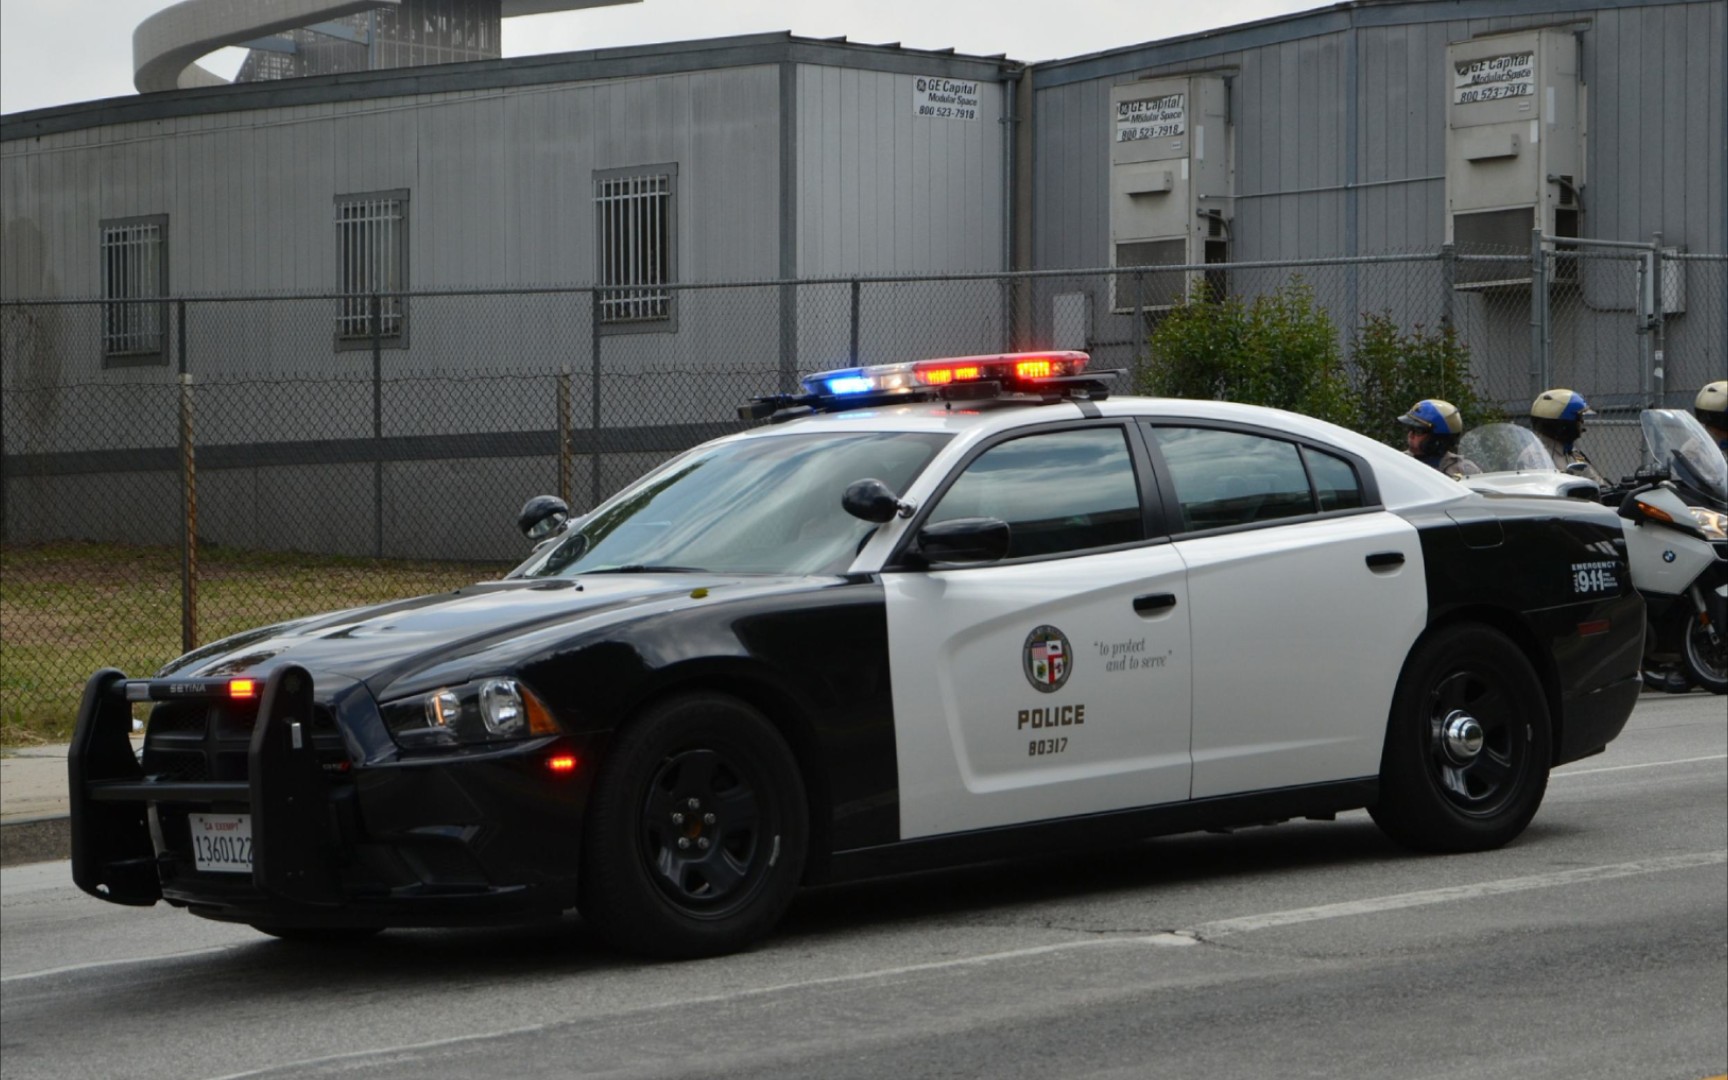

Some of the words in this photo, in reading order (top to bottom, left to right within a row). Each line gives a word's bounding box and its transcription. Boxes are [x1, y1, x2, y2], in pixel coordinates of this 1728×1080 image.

[1471, 61, 1486, 72] GE
[1488, 55, 1530, 71] Capital
[1471, 71, 1505, 83] Modular
[1506, 68, 1531, 80] Space
[928, 79, 941, 91] GE
[943, 80, 978, 95] Capital
[1461, 90, 1478, 103] 800
[1481, 84, 1527, 99] 523-7918
[928, 92, 956, 104] Modular
[957, 95, 978, 107] Space
[1131, 101, 1143, 112] GE
[1145, 95, 1181, 112] Capital
[919, 105, 935, 115] 800
[936, 107, 975, 119] 523-7918
[1160, 111, 1182, 122] Space
[1121, 129, 1137, 140] 800
[1140, 124, 1179, 137] 523-7918
[1571, 561, 1616, 571] EMERGENCY
[1111, 637, 1145, 658] protect
[1105, 654, 1126, 672] and
[1129, 655, 1139, 670] to
[170, 683, 207, 693] SETINA
[1017, 704, 1085, 730] POLICE
[1028, 737, 1068, 757] 80317
[214, 822, 239, 831] EXEMPT
[196, 835, 253, 864] 1360122
